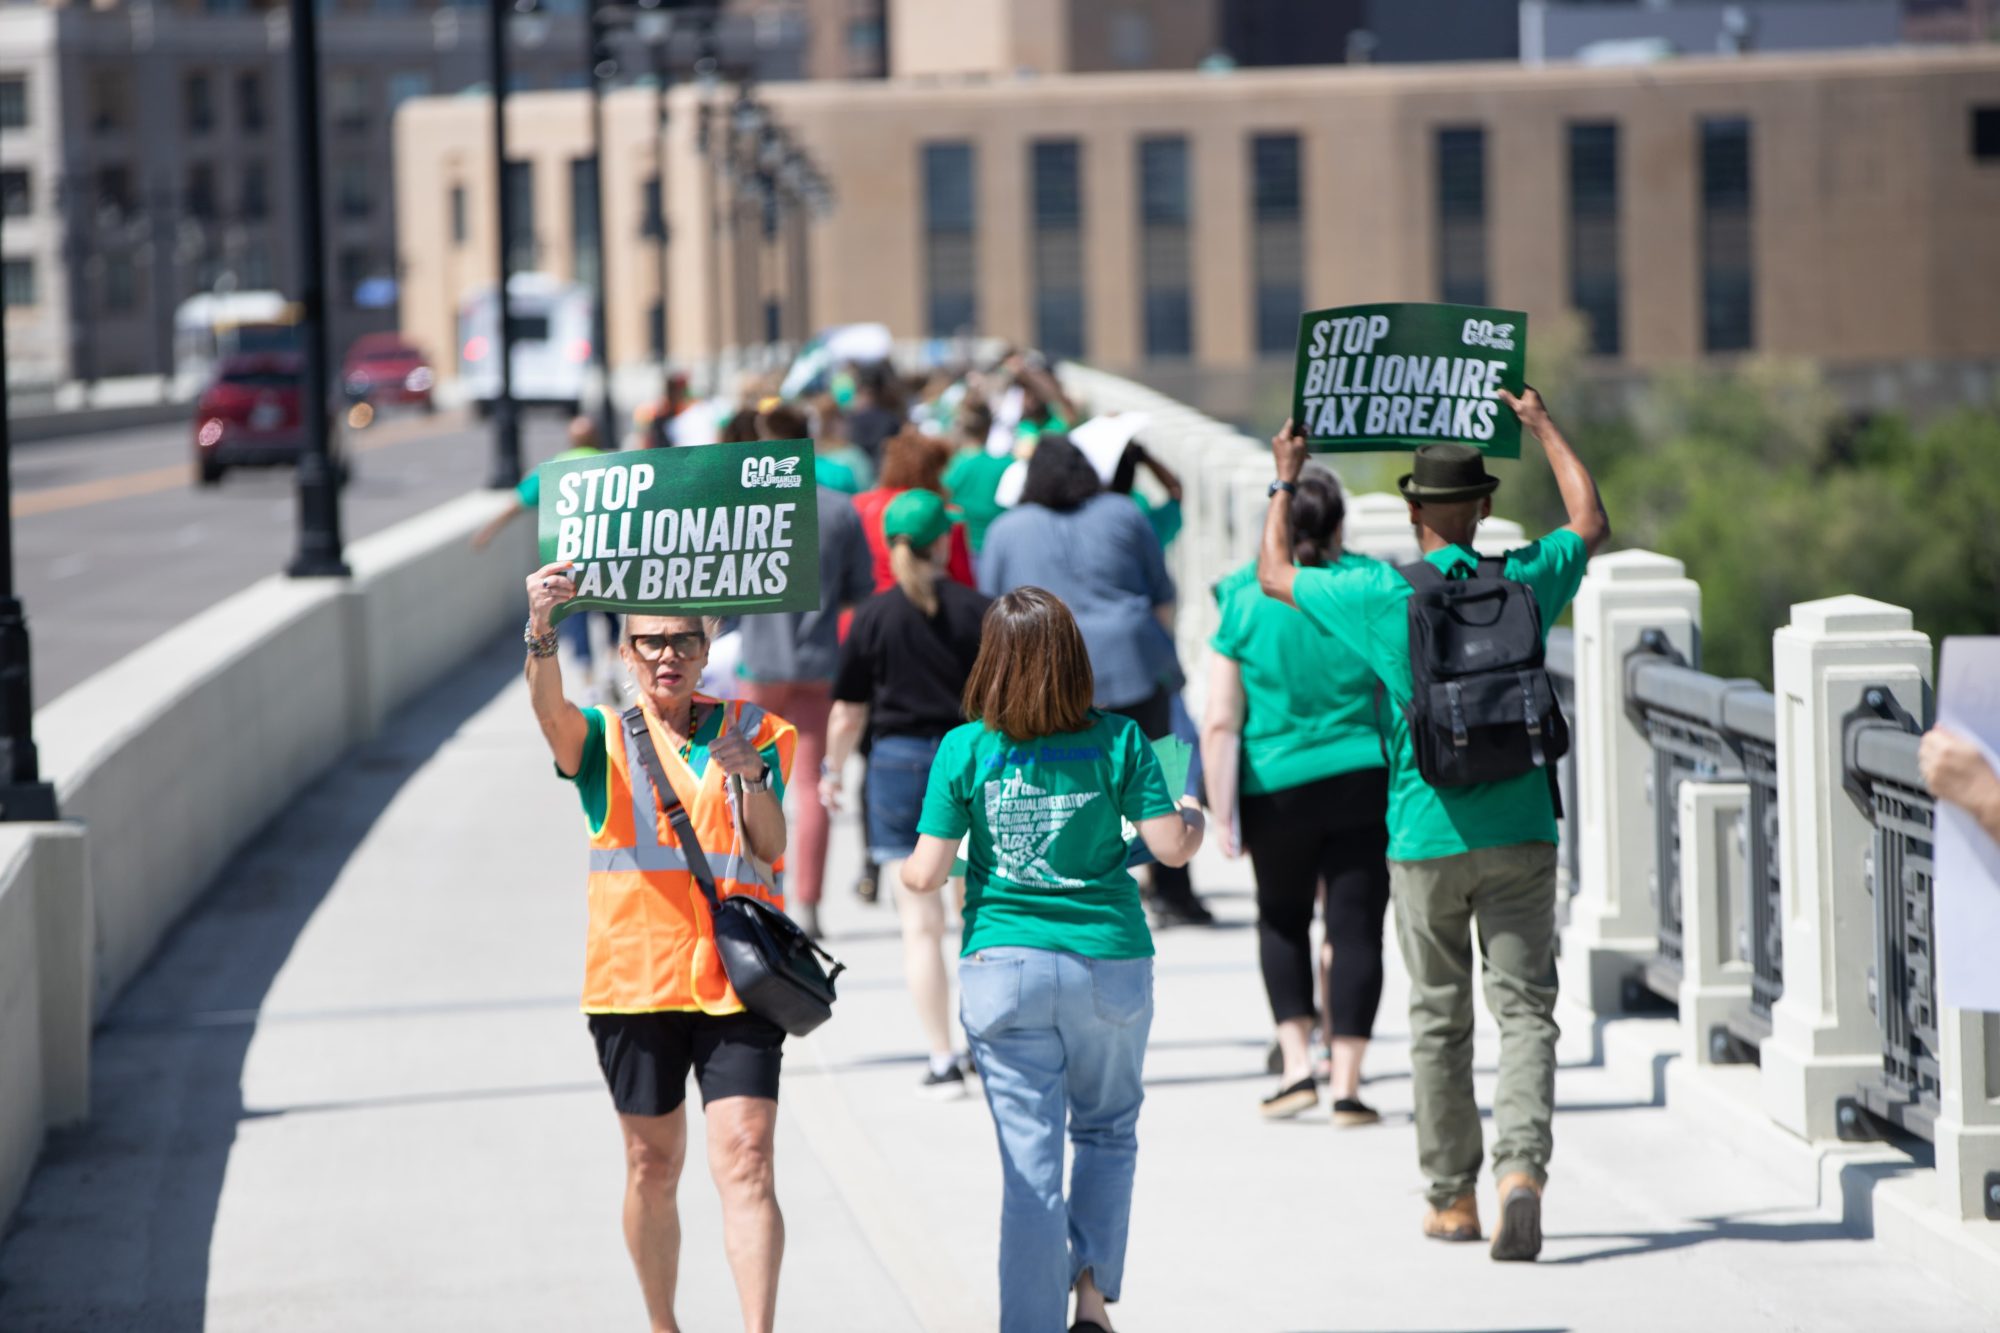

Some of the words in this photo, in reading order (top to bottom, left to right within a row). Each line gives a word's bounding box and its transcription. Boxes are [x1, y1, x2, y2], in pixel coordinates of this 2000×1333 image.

[1308, 315, 1390, 358] STOP
[1302, 355, 1508, 399] BILLIONAIRE
[1303, 396, 1361, 437] TAX
[1364, 396, 1498, 440] BREAKS
[556, 464, 655, 516] STOP
[556, 503, 796, 562] BILLIONAIRE
[637, 551, 790, 600] BREAKS
